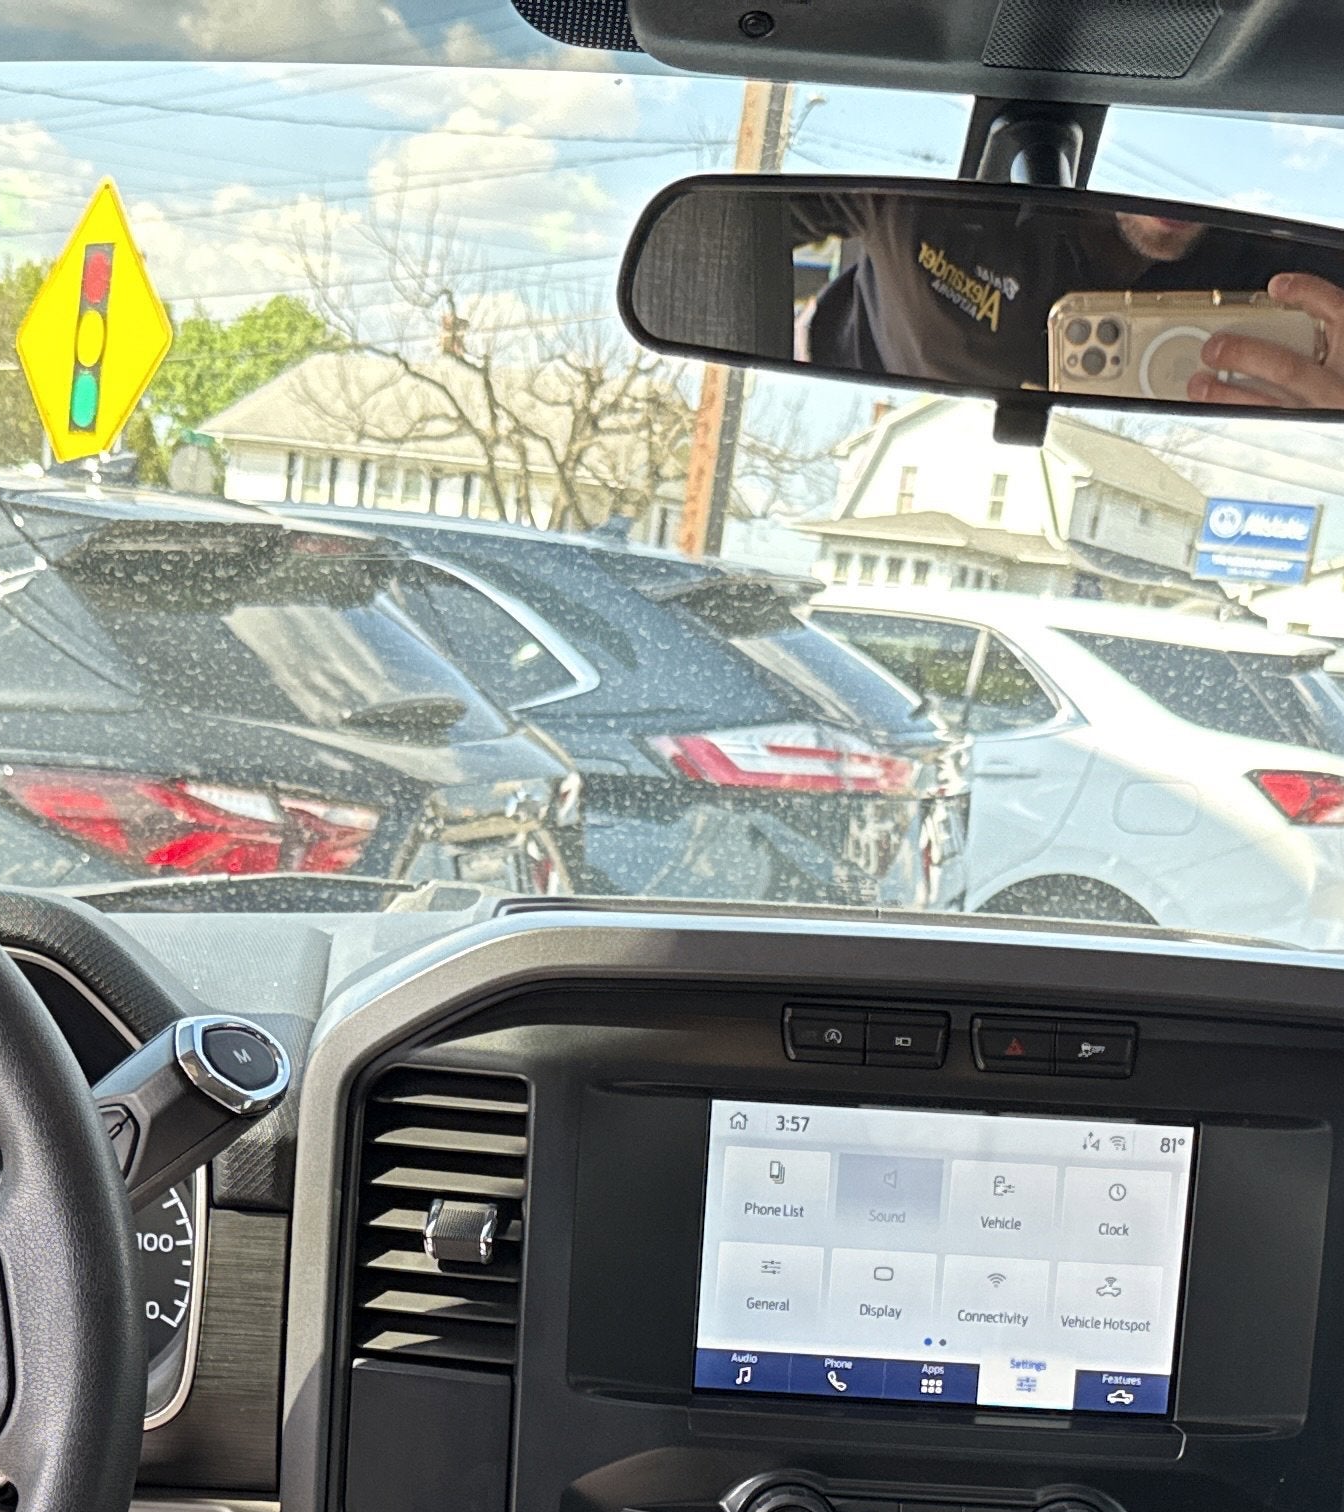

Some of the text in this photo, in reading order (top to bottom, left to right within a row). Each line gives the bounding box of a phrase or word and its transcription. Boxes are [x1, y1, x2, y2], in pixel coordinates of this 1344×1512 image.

[233, 1048, 252, 1065] M
[775, 1114, 810, 1132] 3:57
[744, 1202, 804, 1218] Phone List
[868, 1209, 906, 1223] Sound
[980, 1216, 1022, 1231] Vehicle
[1098, 1223, 1129, 1237] Clock
[136, 1232, 174, 1252] 100
[746, 1296, 790, 1311] General
[859, 1303, 902, 1320] Display
[957, 1309, 1029, 1327] Connectivity
[1061, 1315, 1151, 1333] Vehicle Hotspot
[730, 1352, 758, 1364] Audio
[824, 1358, 853, 1370] Phone
[1009, 1359, 1047, 1371] Settings
[921, 1364, 945, 1376] Apps
[1101, 1374, 1142, 1387] Features
